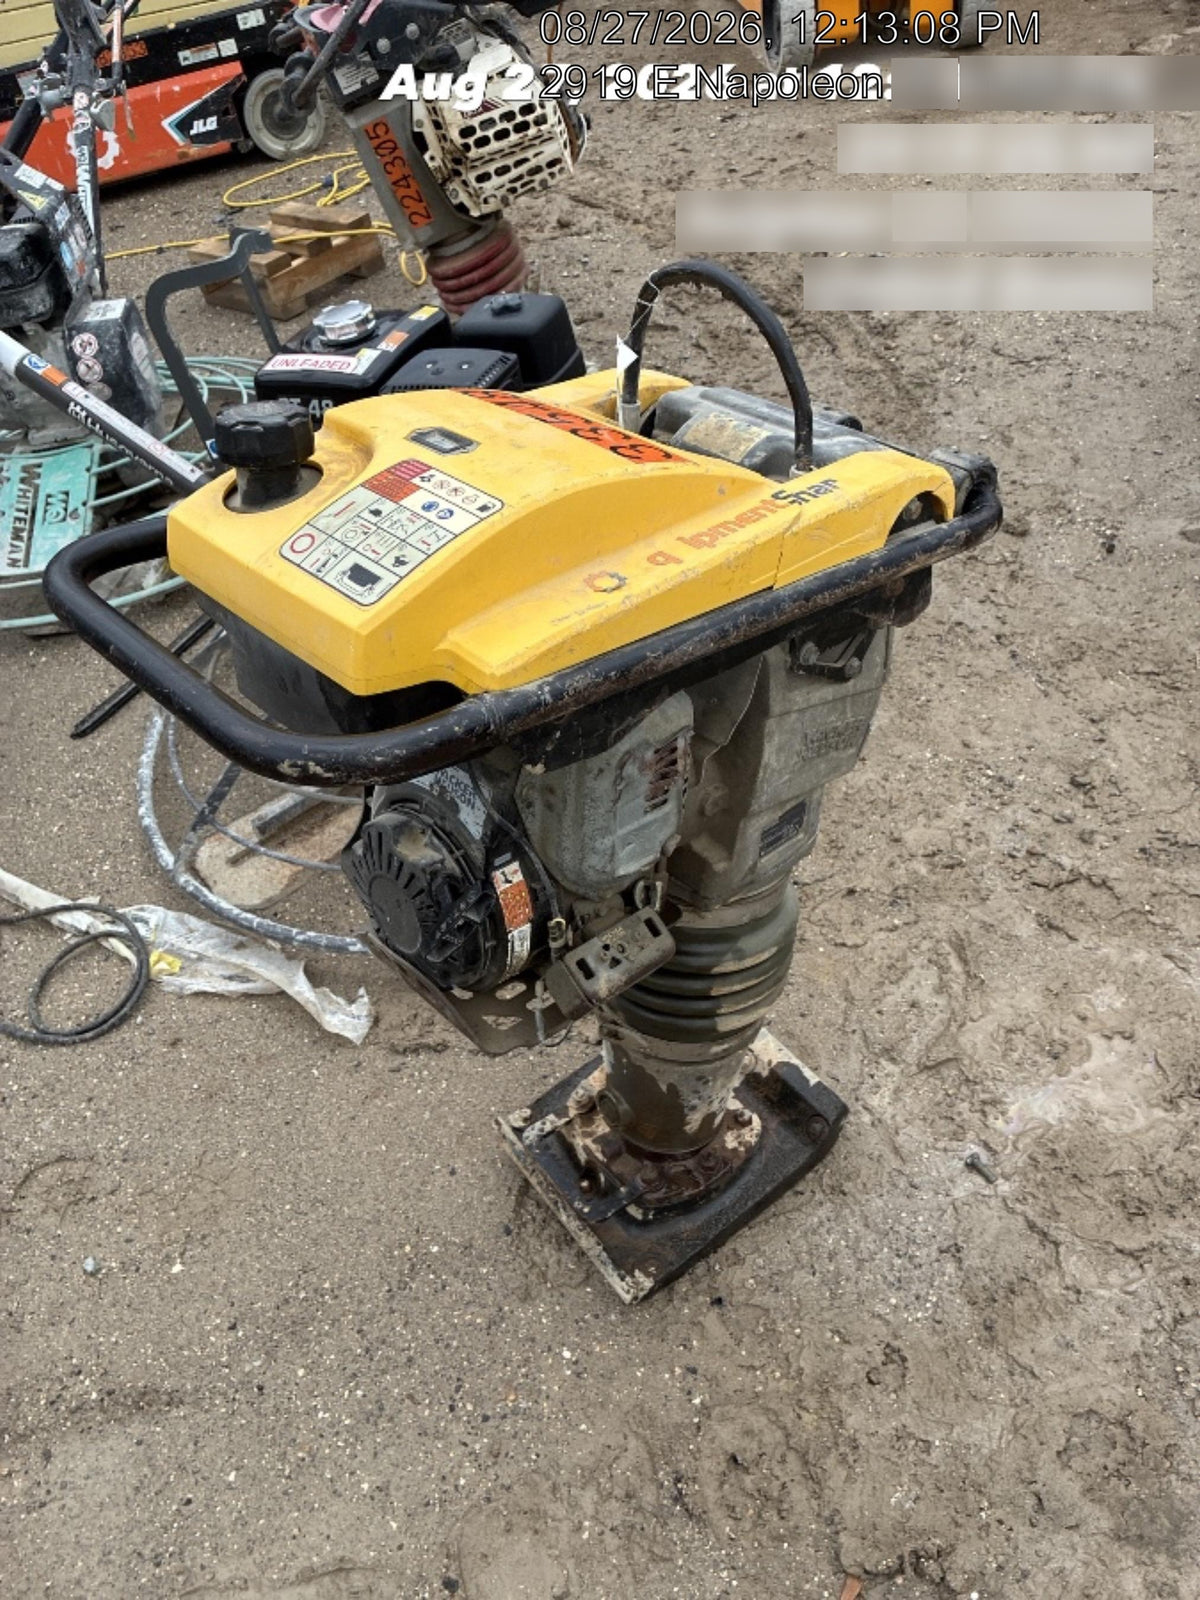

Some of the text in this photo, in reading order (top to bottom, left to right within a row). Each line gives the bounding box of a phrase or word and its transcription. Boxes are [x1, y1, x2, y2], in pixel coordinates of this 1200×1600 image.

[190, 115, 218, 135] JLG
[364, 121, 433, 226] 224305
[271, 358, 352, 371] UNLEADED
[6, 462, 43, 569] WHITEMAN
